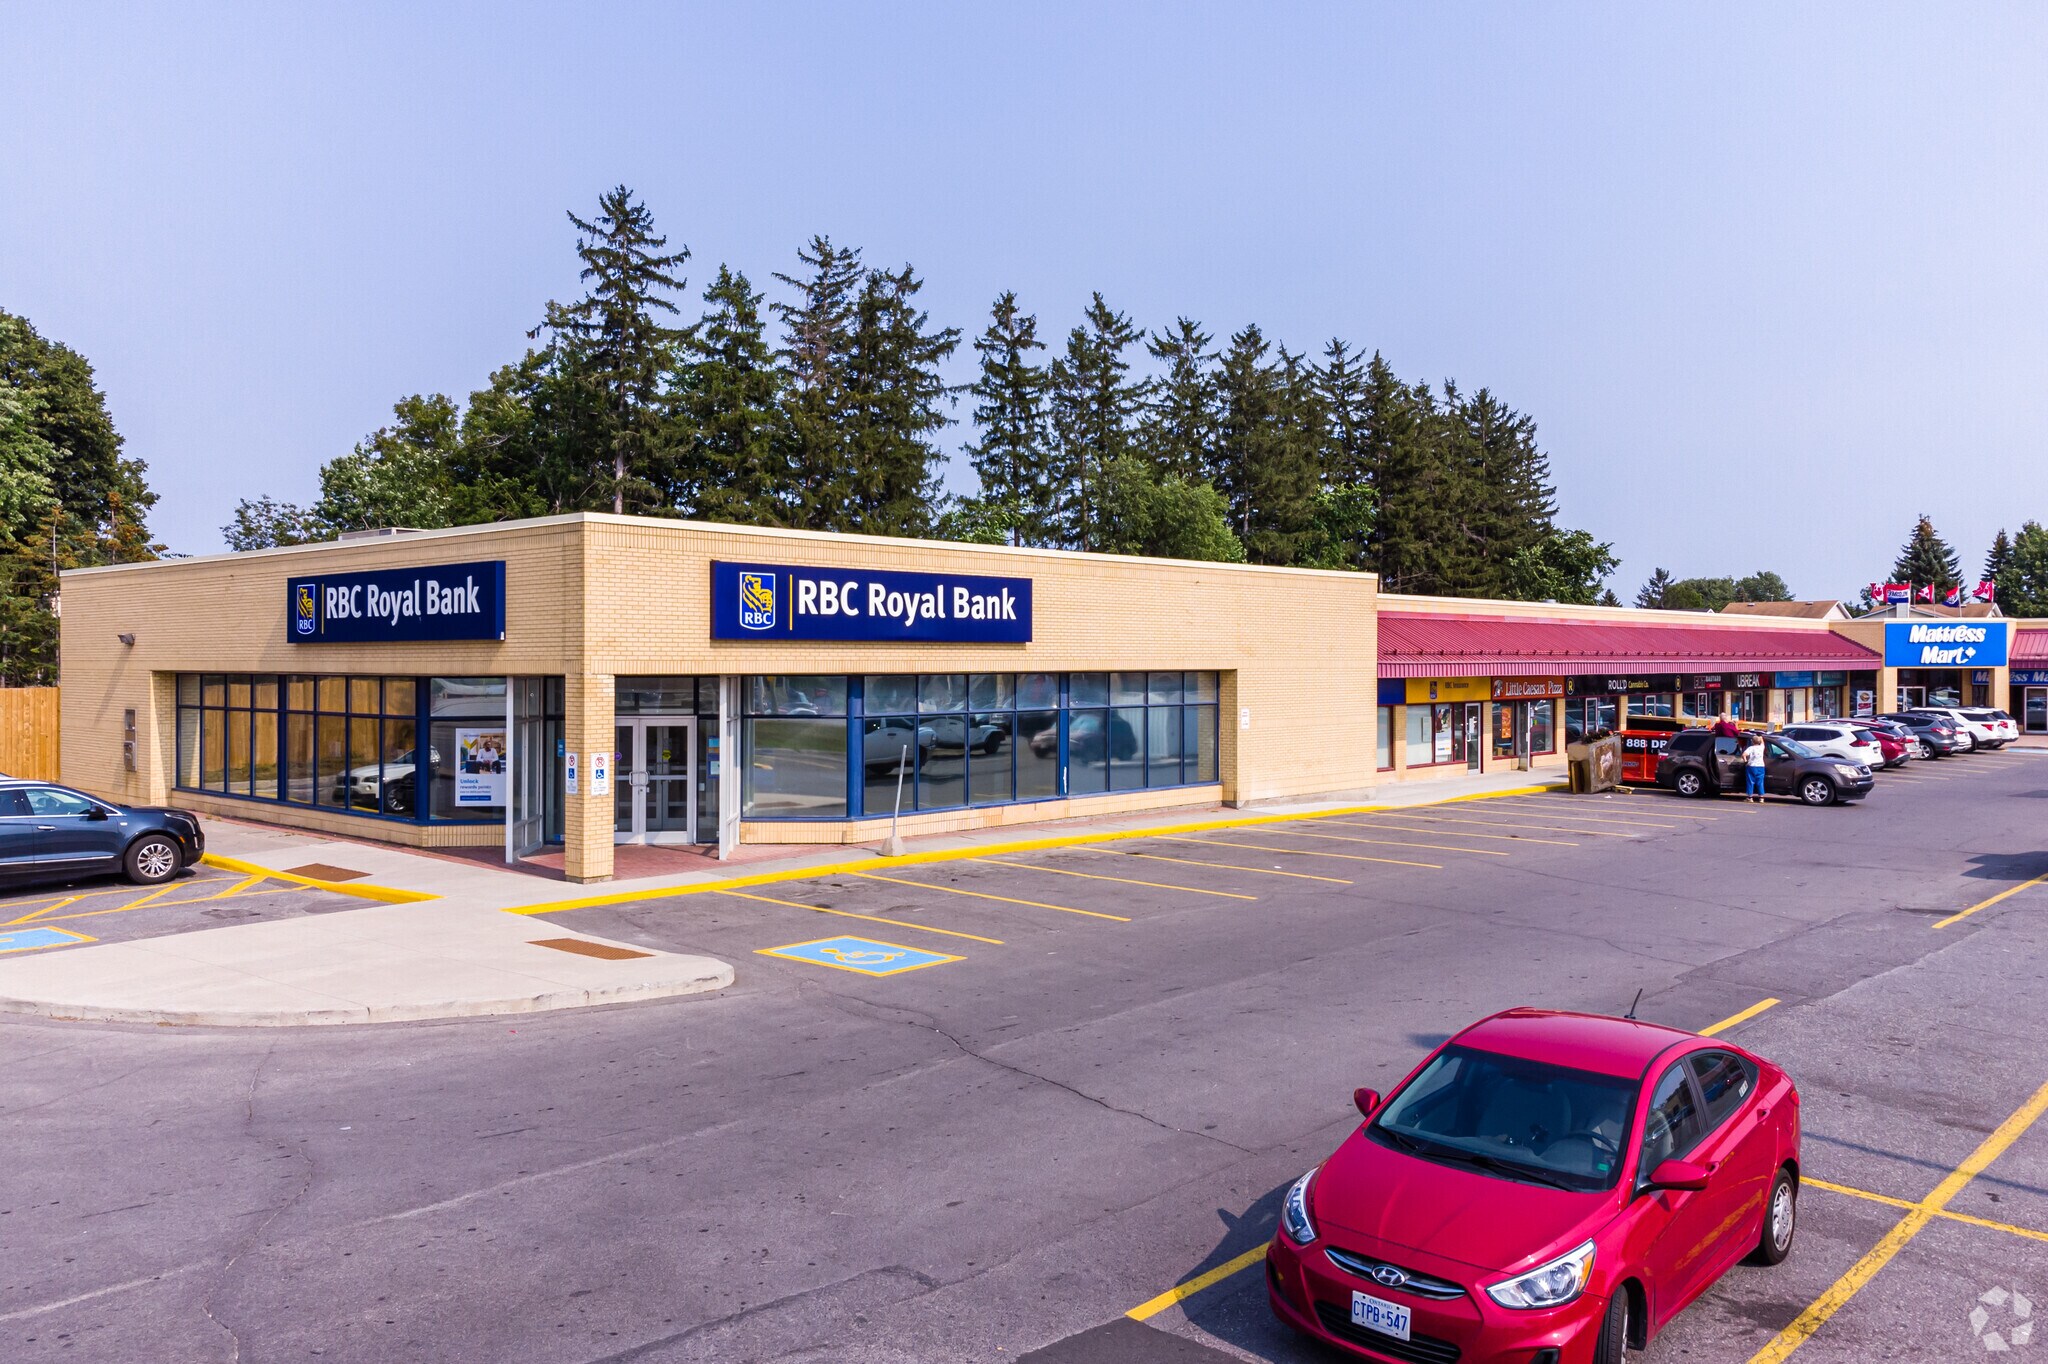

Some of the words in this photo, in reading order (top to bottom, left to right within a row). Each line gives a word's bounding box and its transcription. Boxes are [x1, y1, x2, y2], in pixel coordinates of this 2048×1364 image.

[326, 585, 361, 619] RBC
[367, 579, 422, 627] Royal
[427, 575, 481, 616] Bank
[798, 579, 859, 616] RBC
[868, 583, 946, 627] Royal
[953, 587, 1017, 620] Bank
[299, 620, 313, 630] RBC
[744, 612, 772, 625] RBC
[1920, 646, 1969, 664] Mart
[1505, 682, 1522, 696] Little
[1523, 681, 1546, 696] Caesars
[1547, 680, 1563, 695] Pizza
[1568, 680, 1573, 691] R
[1626, 738, 1648, 748] 888
[1369, 1299, 1392, 1309] ONTARIO
[1354, 1301, 1379, 1322] CTPB
[1387, 1311, 1407, 1331] 547
